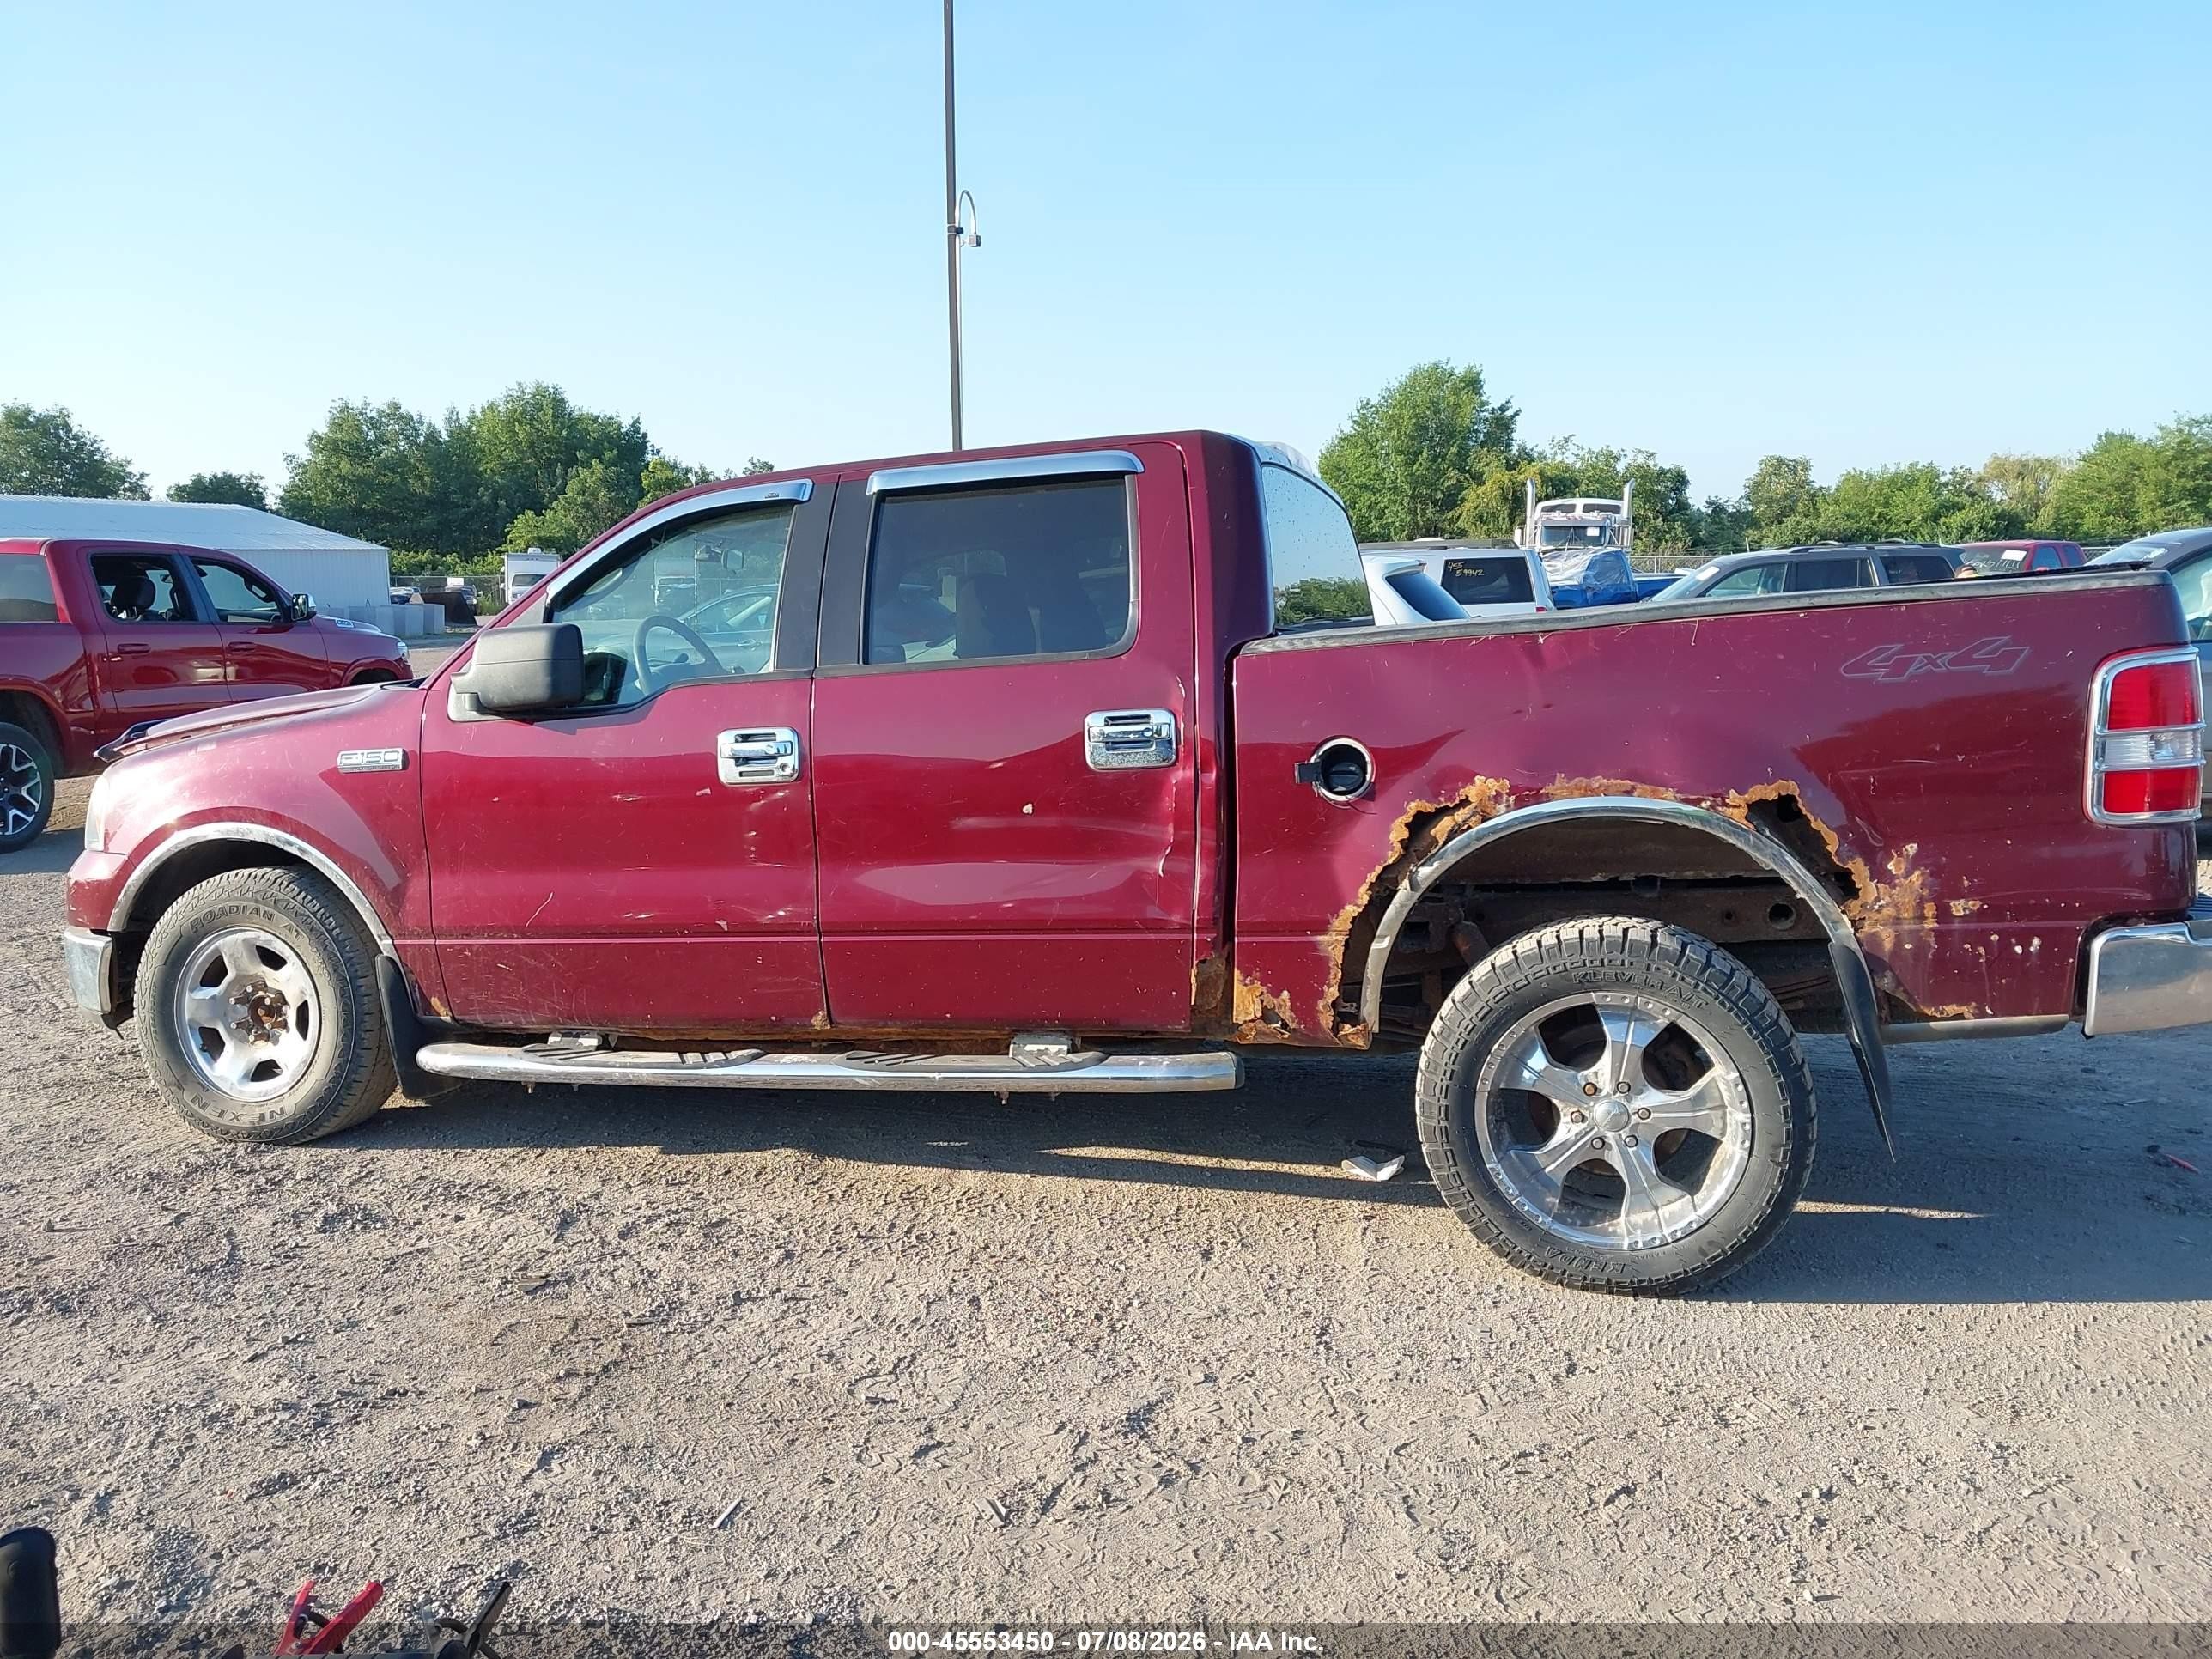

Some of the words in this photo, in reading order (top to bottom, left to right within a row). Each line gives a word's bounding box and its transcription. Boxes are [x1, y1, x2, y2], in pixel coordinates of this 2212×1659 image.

[1841, 635, 2031, 683] 4x4
[190, 904, 276, 933] ROADIAN
[1572, 970, 1664, 990] KLEVER
[191, 1092, 287, 1122] NEXEN
[1545, 1245, 1626, 1274] KENDA
